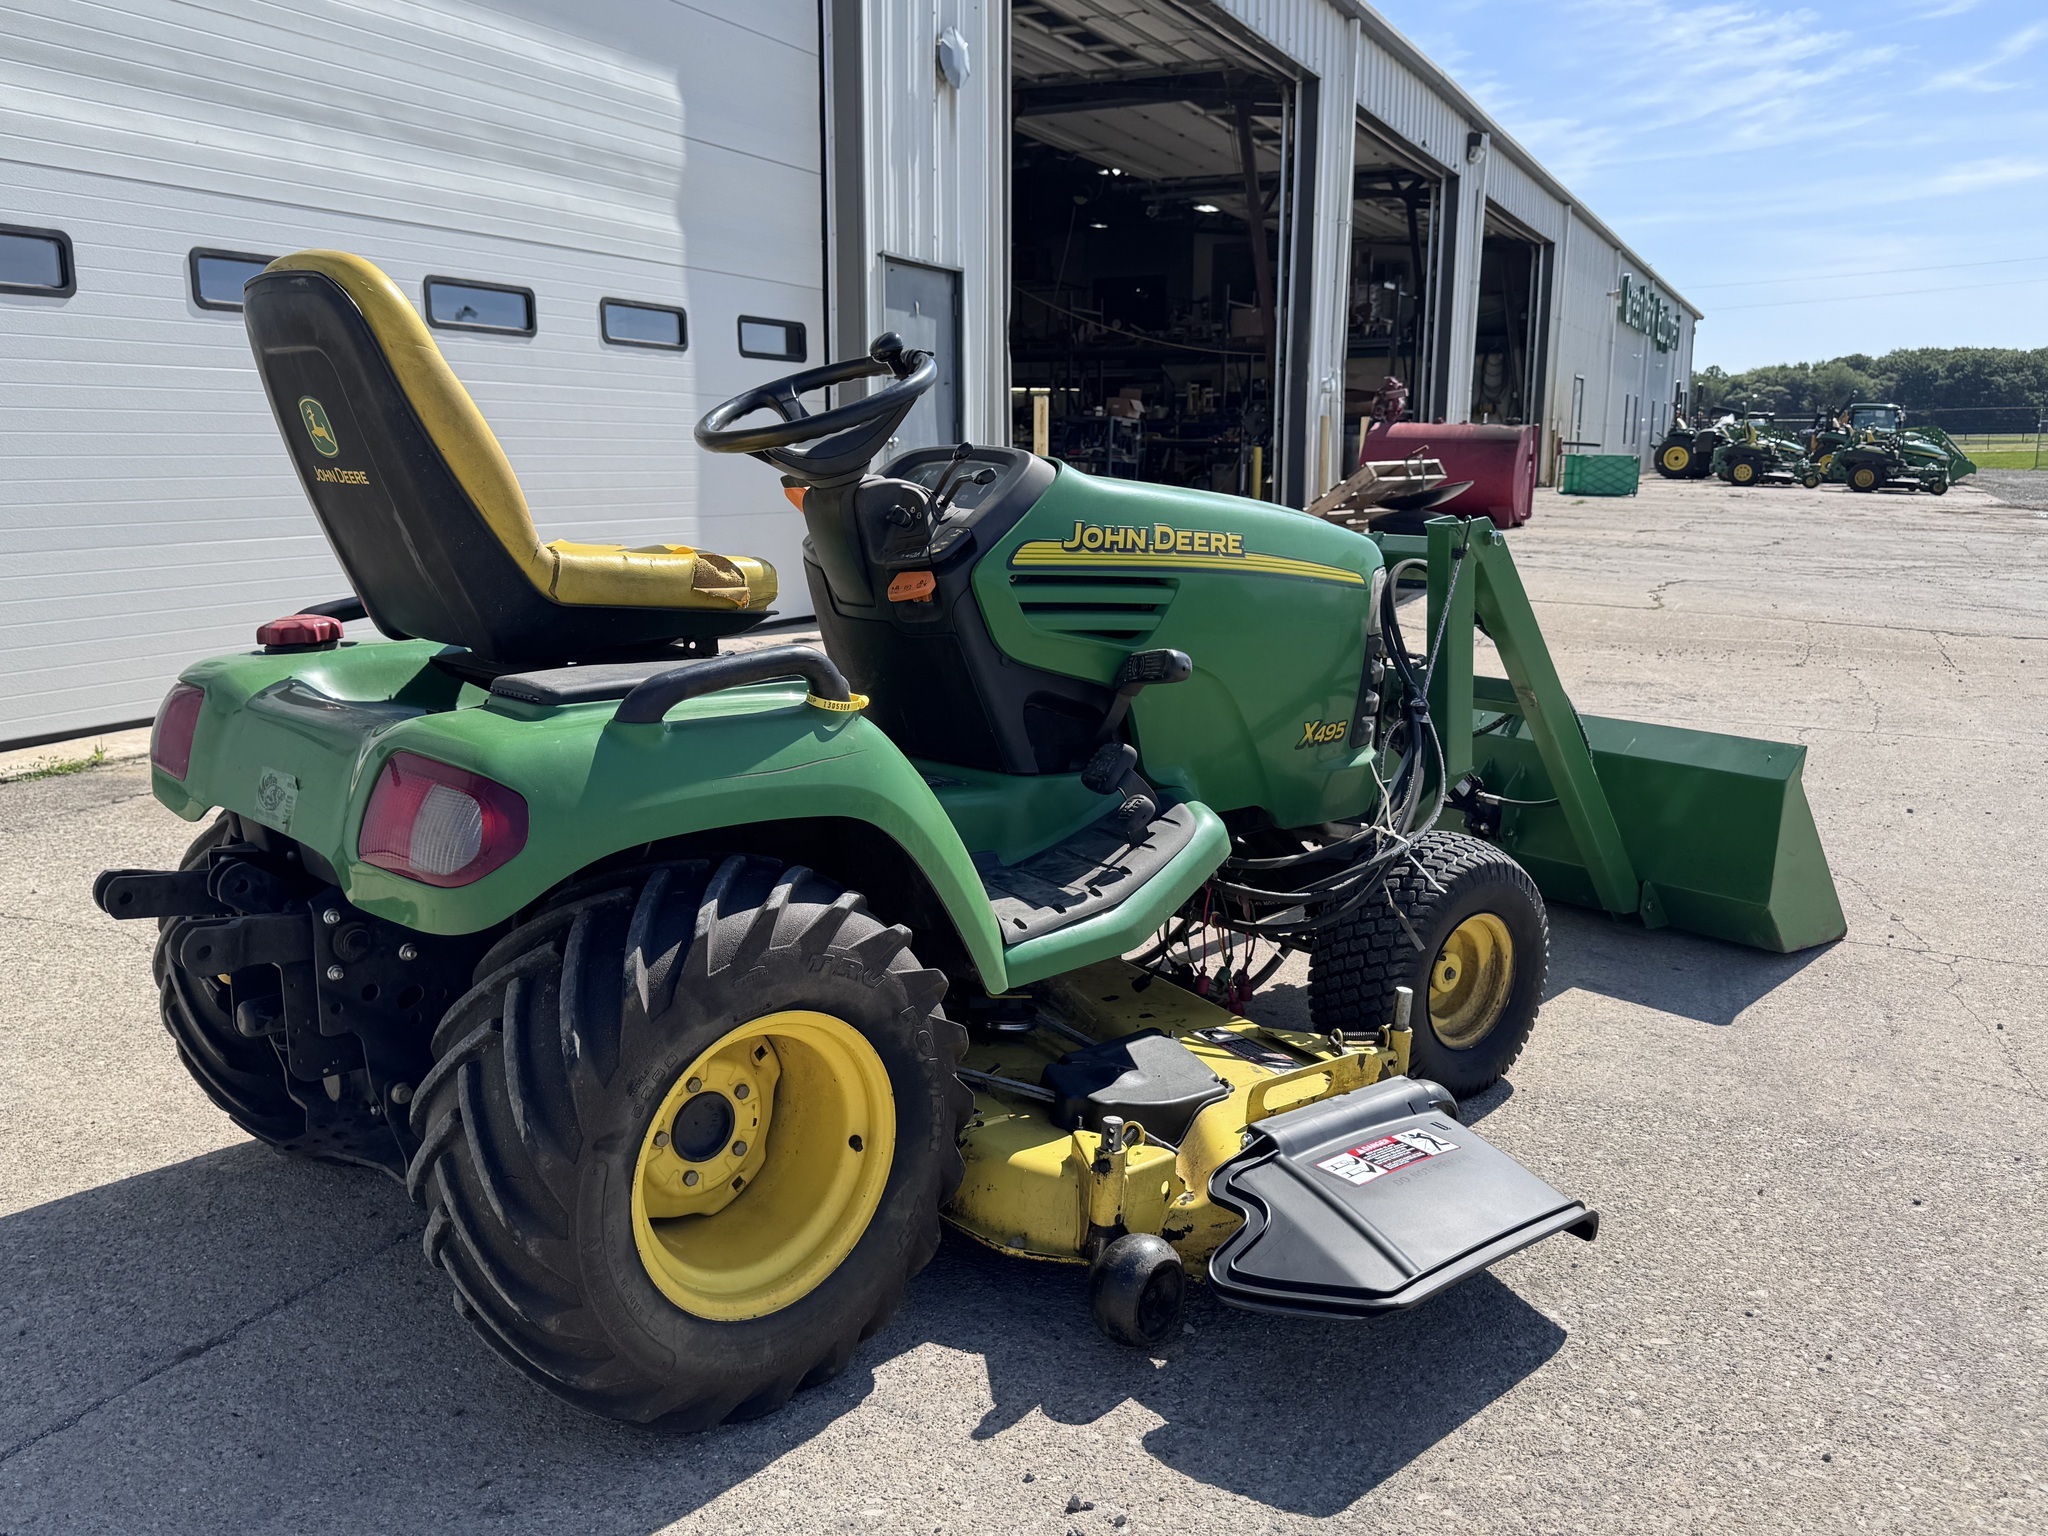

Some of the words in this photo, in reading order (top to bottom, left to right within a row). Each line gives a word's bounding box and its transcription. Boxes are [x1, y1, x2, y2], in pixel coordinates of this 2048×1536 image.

[313, 465, 337, 482] JOHN
[334, 467, 370, 485] DEERE
[1062, 520, 1149, 552] JOHN
[1153, 523, 1246, 557] DEERE
[1296, 719, 1348, 748] X495
[808, 953, 885, 989] TRU
